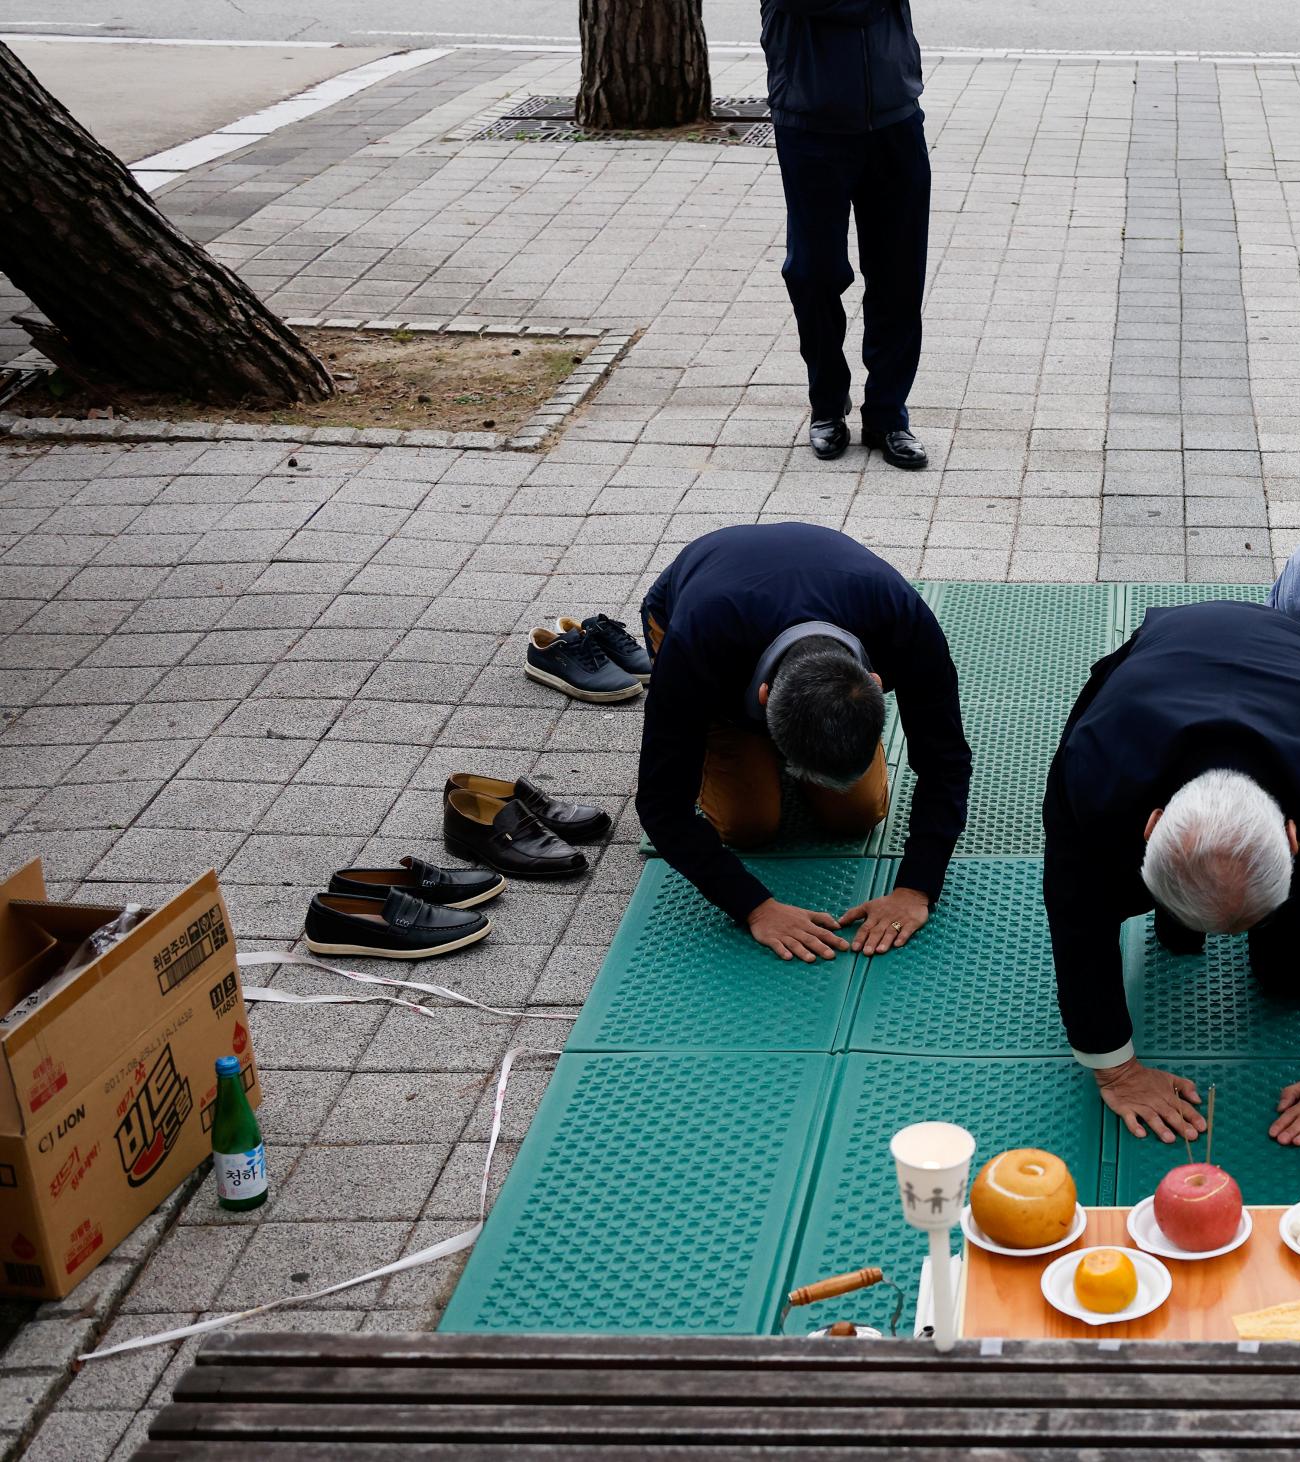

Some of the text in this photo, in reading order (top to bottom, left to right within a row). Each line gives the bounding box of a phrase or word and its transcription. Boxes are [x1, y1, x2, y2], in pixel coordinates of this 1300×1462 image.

[153, 931, 190, 971] 취급주의
[215, 993, 239, 1021] 114831
[113, 1043, 182, 1174] 비트
[38, 1104, 87, 1154] CJ LION
[225, 1165, 258, 1187] 청하
